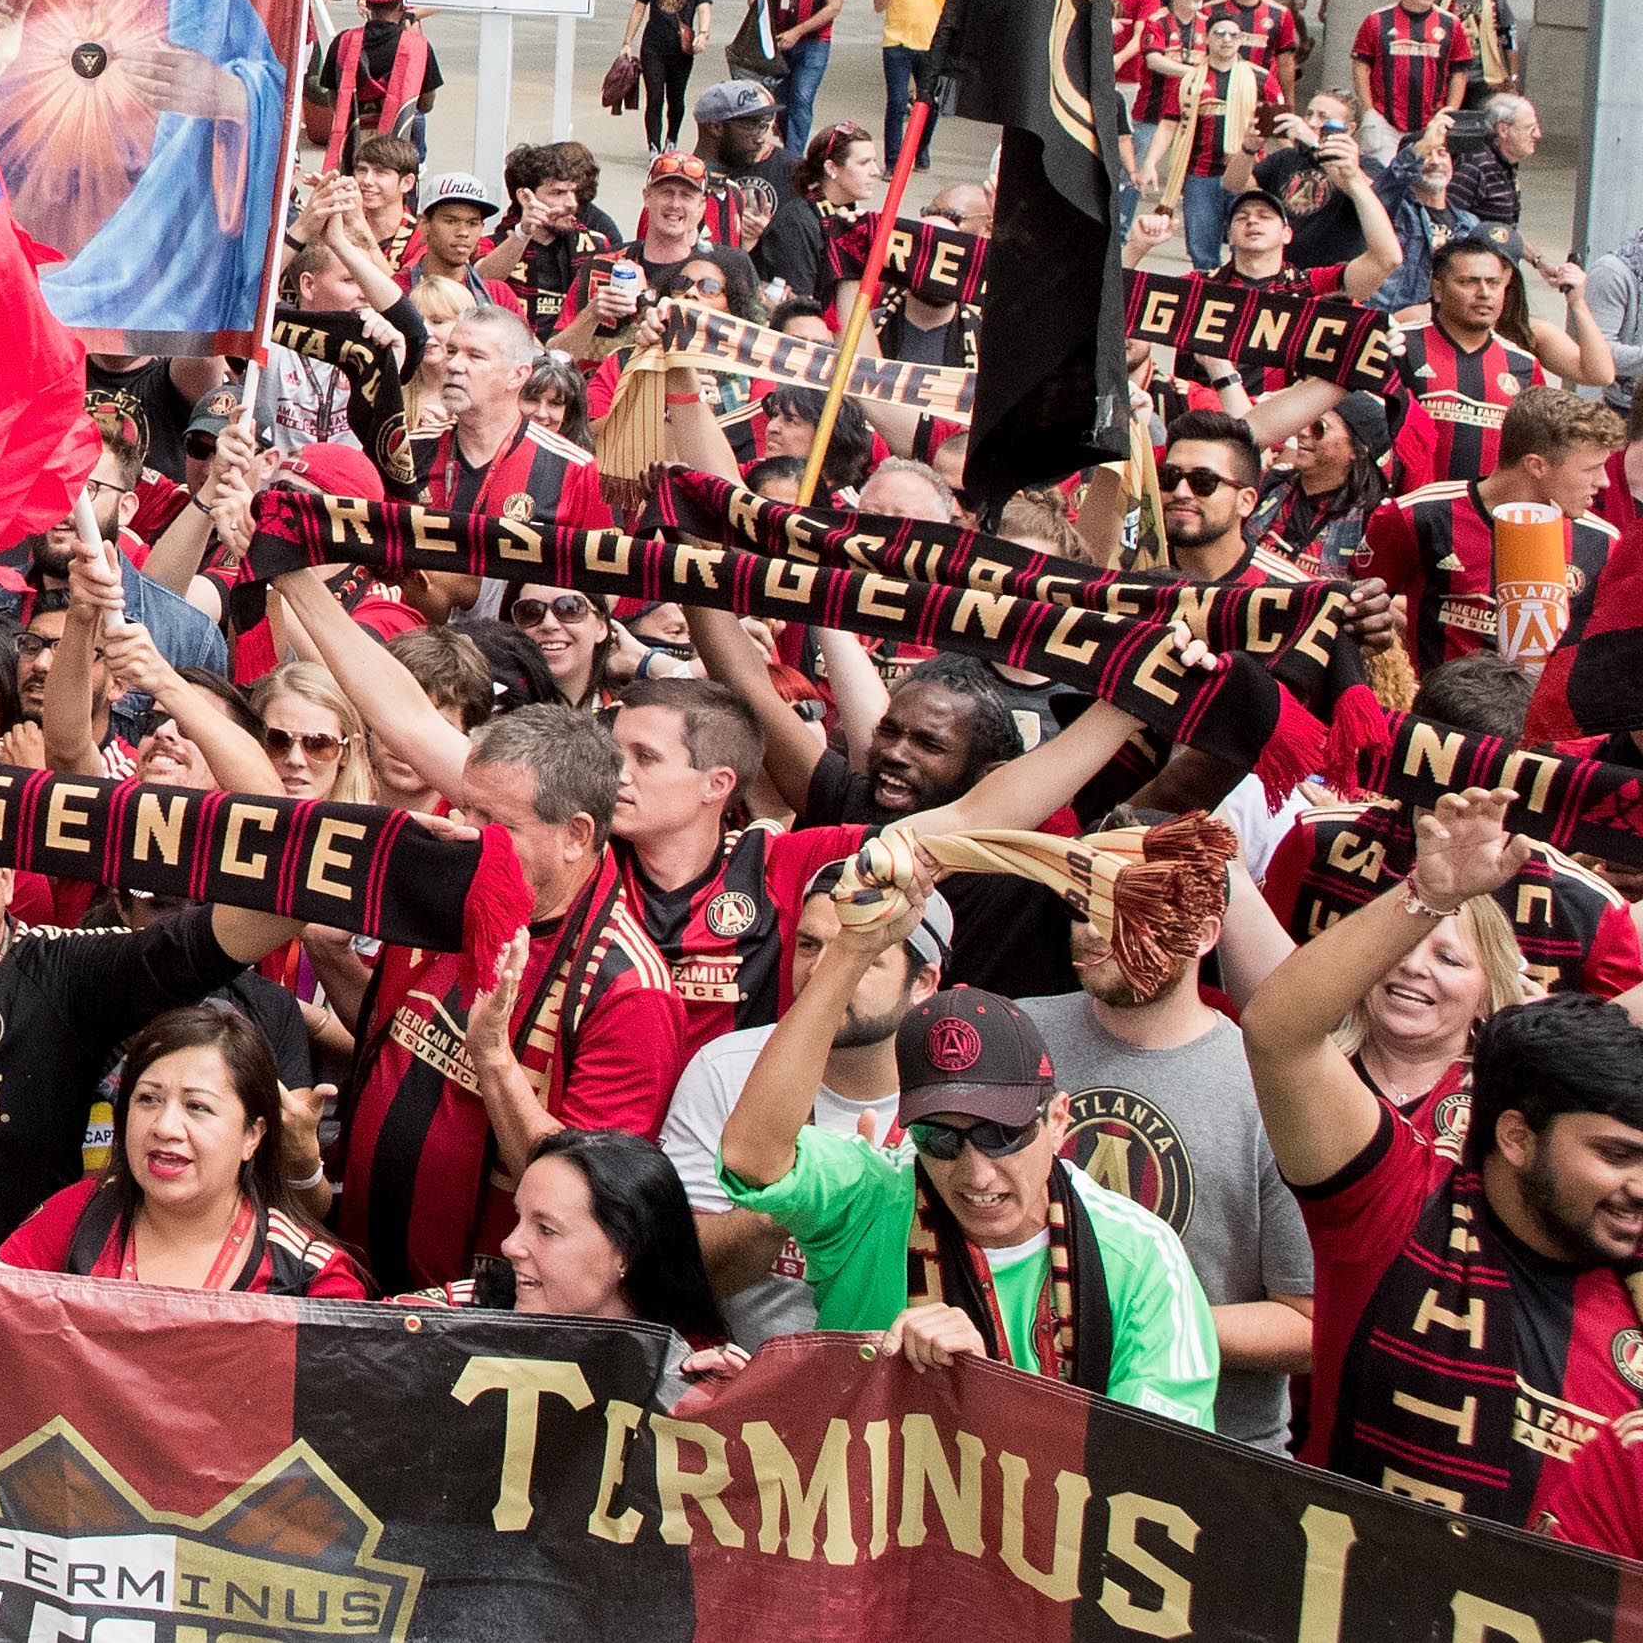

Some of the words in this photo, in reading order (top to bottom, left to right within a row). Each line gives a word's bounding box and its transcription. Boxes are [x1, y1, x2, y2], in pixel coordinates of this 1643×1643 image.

[438, 179, 485, 198] United
[883, 228, 1390, 379] REGENCE
[661, 304, 943, 407] WELCOME
[331, 494, 1190, 705] RESURGENCE
[1062, 1090, 1174, 1155] ATLANTA
[1144, 1391, 1177, 1415] MLS
[450, 1356, 1199, 1641] TERMINUS
